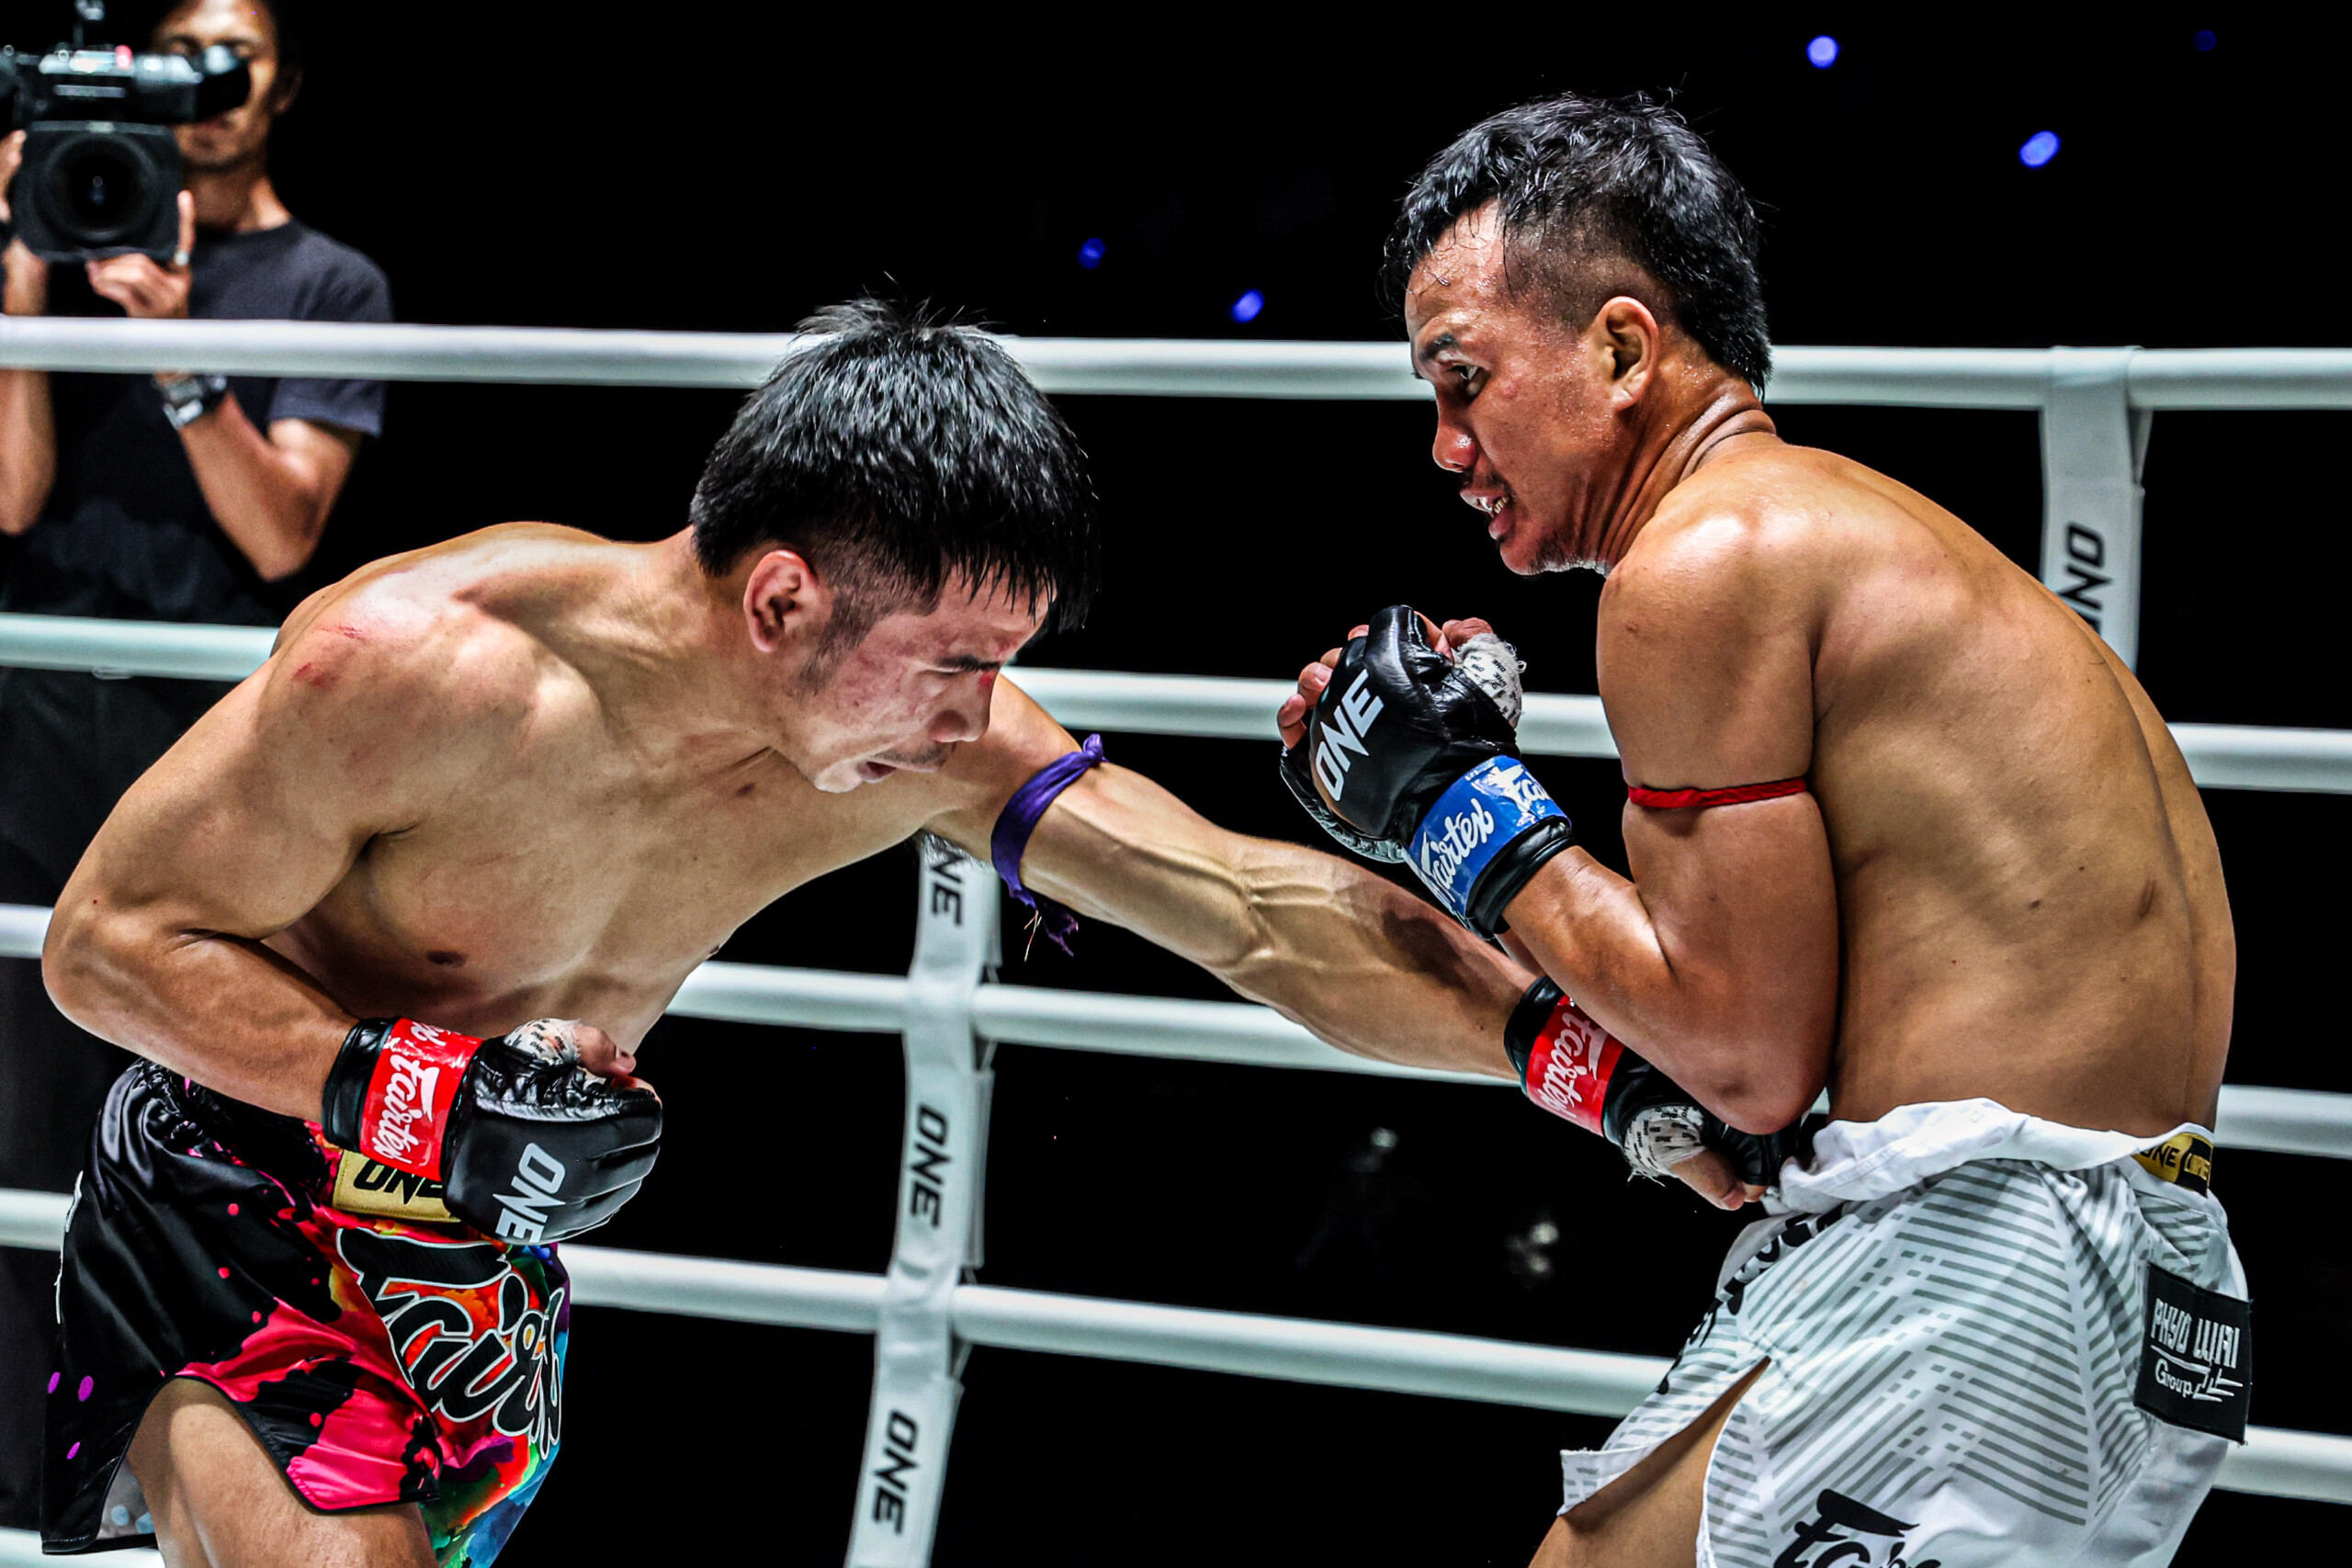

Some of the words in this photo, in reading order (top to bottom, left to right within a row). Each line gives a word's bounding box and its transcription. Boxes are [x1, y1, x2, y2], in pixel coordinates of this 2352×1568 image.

[1313, 670, 1384, 801] ONE
[930, 846, 964, 927] NE
[373, 1054, 441, 1165] Fairtex
[1537, 1012, 1609, 1119] Fairtex
[492, 1142, 566, 1244] ONE
[909, 1104, 951, 1229] ONE
[2151, 1297, 2193, 1354] PHYO
[2155, 1358, 2194, 1398] Group
[872, 1409, 921, 1535] ONE
